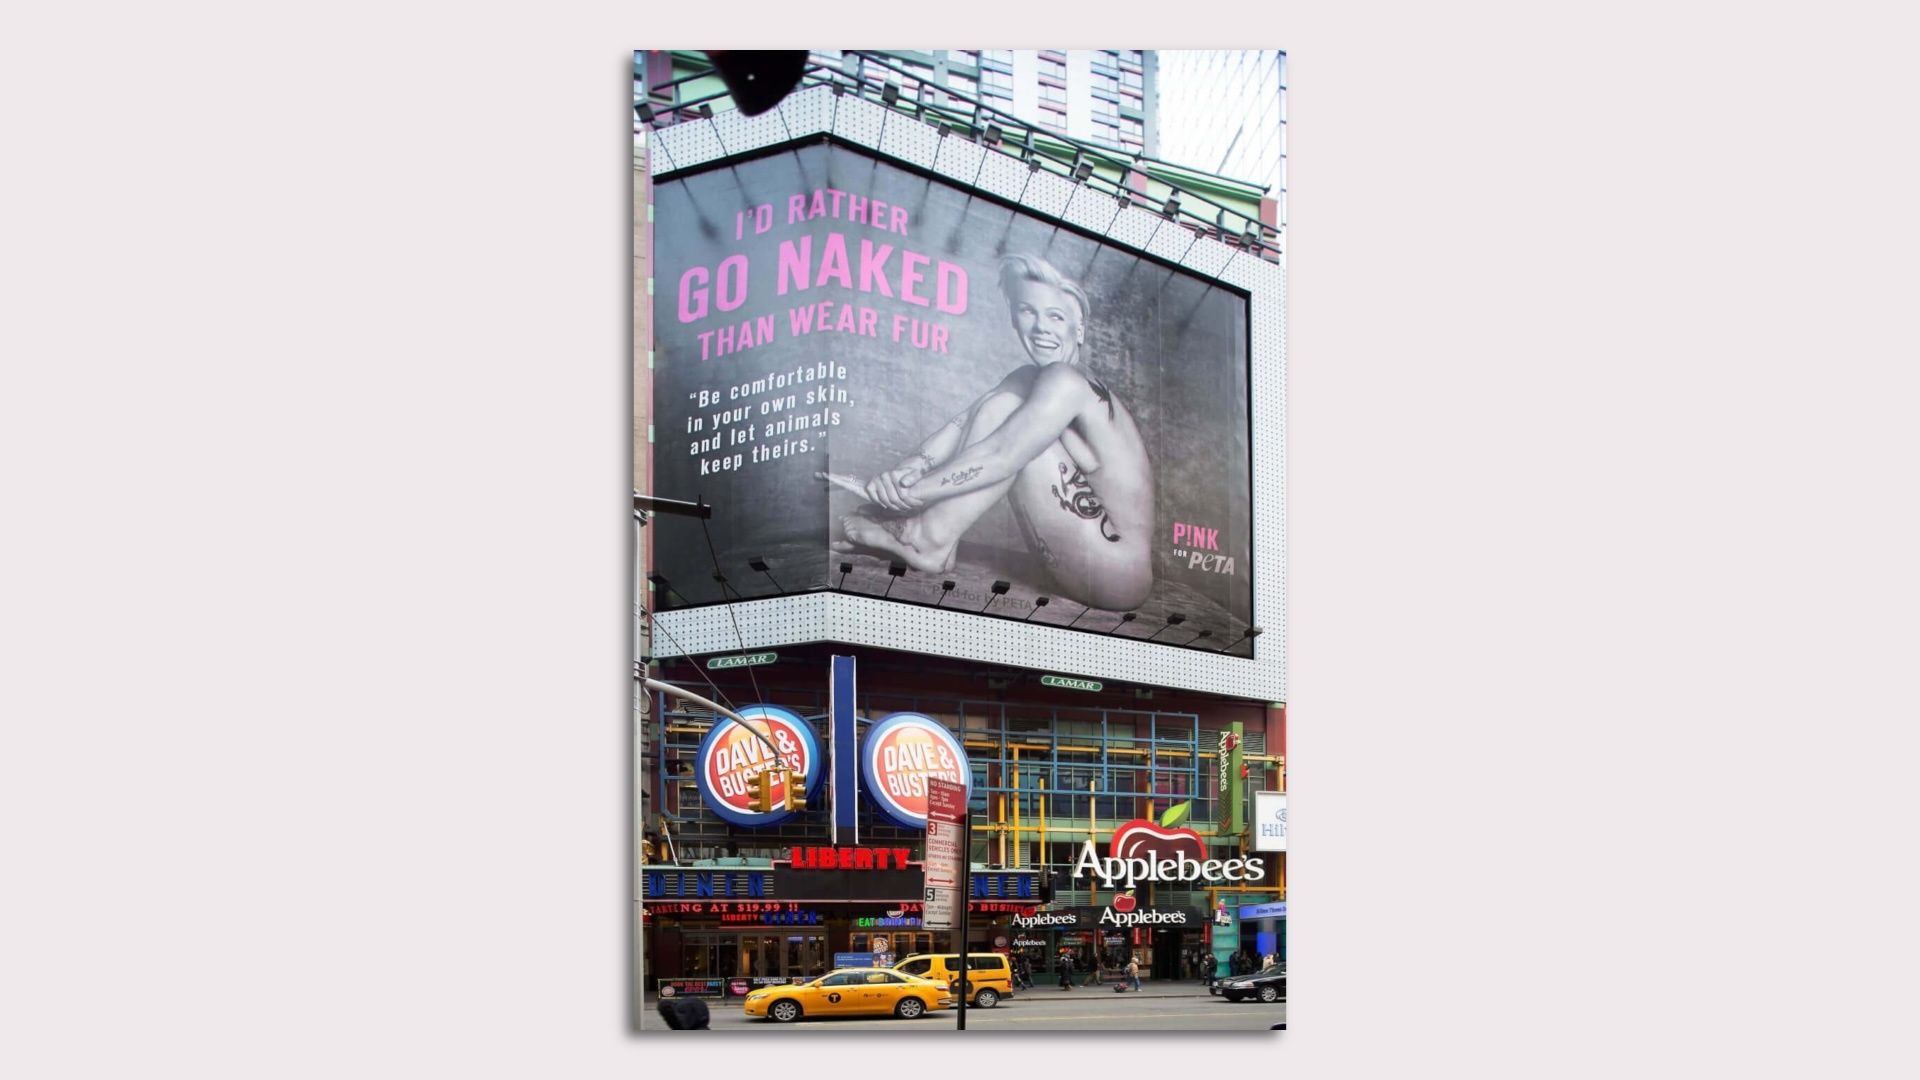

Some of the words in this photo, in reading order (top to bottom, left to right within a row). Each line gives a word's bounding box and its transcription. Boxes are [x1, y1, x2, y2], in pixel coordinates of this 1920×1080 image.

[735, 203, 773, 241] I'D
[787, 188, 908, 236] RATHER
[677, 254, 749, 324] GO
[777, 232, 969, 316] NAKED
[697, 314, 775, 361] THAN
[789, 301, 878, 338] WEAR
[891, 313, 949, 353] FUR
[730, 361, 847, 399] comfortable
[687, 417, 703, 434] in
[712, 406, 751, 430] your
[761, 395, 796, 415] own
[806, 385, 855, 407] skin,
[690, 432, 721, 455] and
[730, 424, 755, 446] let
[765, 408, 841, 438] animals
[700, 454, 743, 476] keep
[1173, 522, 1219, 551] P!NK
[1173, 549, 1187, 558] FOR
[717, 655, 767, 667] LAMAR
[1050, 677, 1094, 690] LAMAR
[716, 733, 776, 776] DAVE
[775, 730, 798, 754] &
[884, 743, 939, 772] DAVE
[937, 745, 956, 770] &
[929, 823, 936, 835] 3
[791, 846, 910, 869] LIBERTY
[1073, 839, 1266, 889] Applebee's
[648, 873, 765, 897] DINER
[926, 889, 934, 901] 5
[710, 903, 728, 913] AT
[737, 903, 780, 913] $19.99
[721, 913, 759, 921] LIBERTY
[1099, 906, 1187, 928] Applebee's
[858, 917, 875, 928] EAT
[1011, 913, 1077, 928] Applebee's
